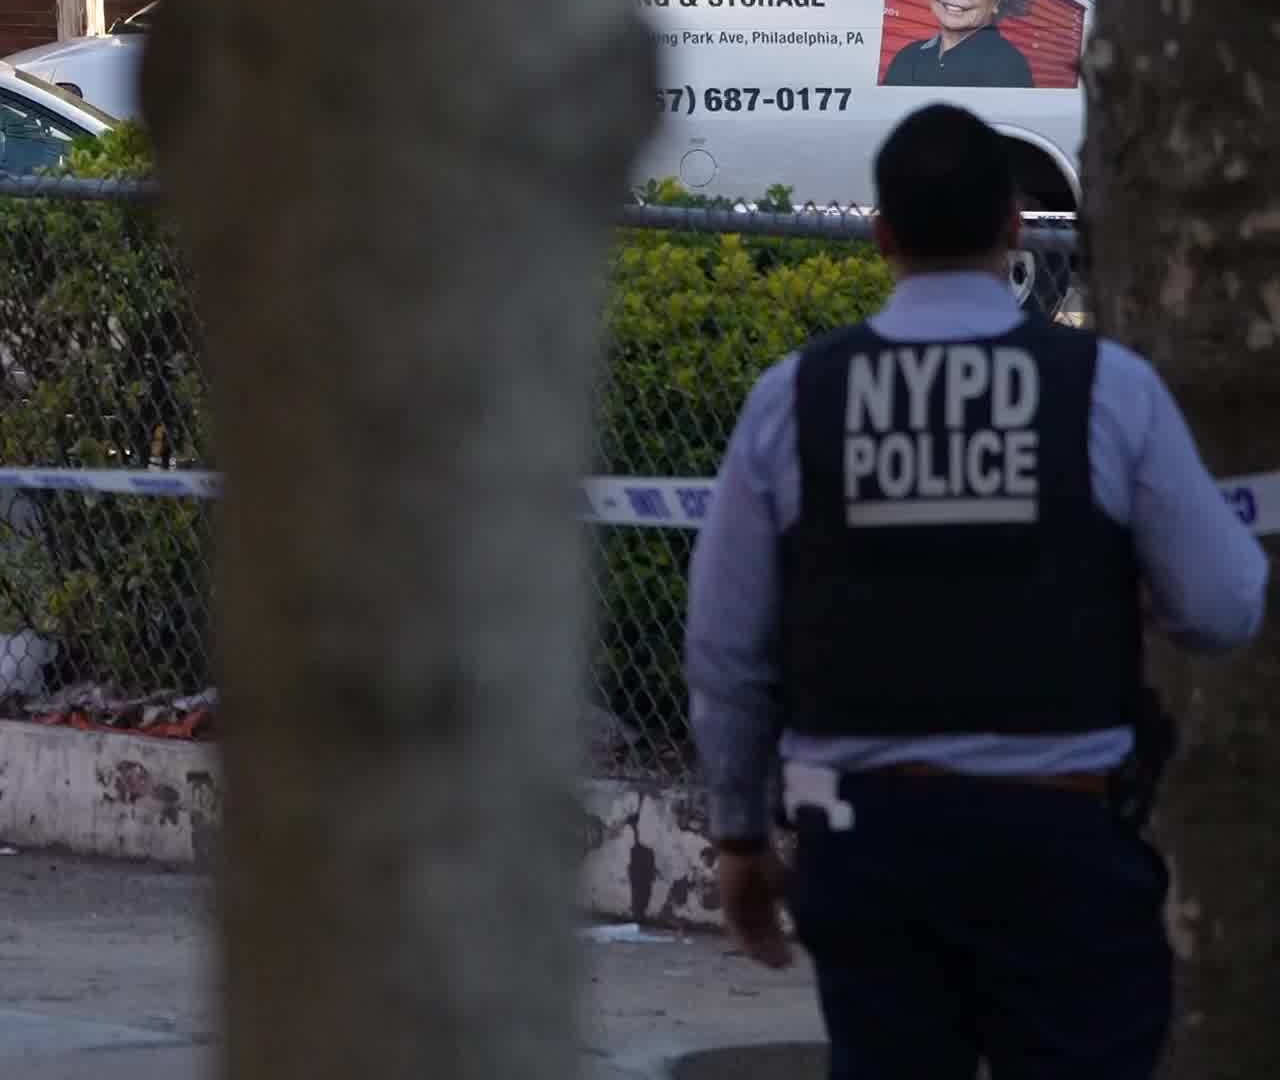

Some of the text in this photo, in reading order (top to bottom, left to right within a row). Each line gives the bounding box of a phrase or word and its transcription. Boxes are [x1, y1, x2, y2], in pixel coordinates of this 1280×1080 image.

[683, 31, 714, 45] Park
[719, 31, 748, 46] Ave,
[752, 31, 842, 47] Philadelphia,
[846, 31, 864, 45] PA
[704, 87, 852, 112] 687-0177
[845, 345, 1038, 433] NYPD
[844, 432, 1038, 497] POLICE
